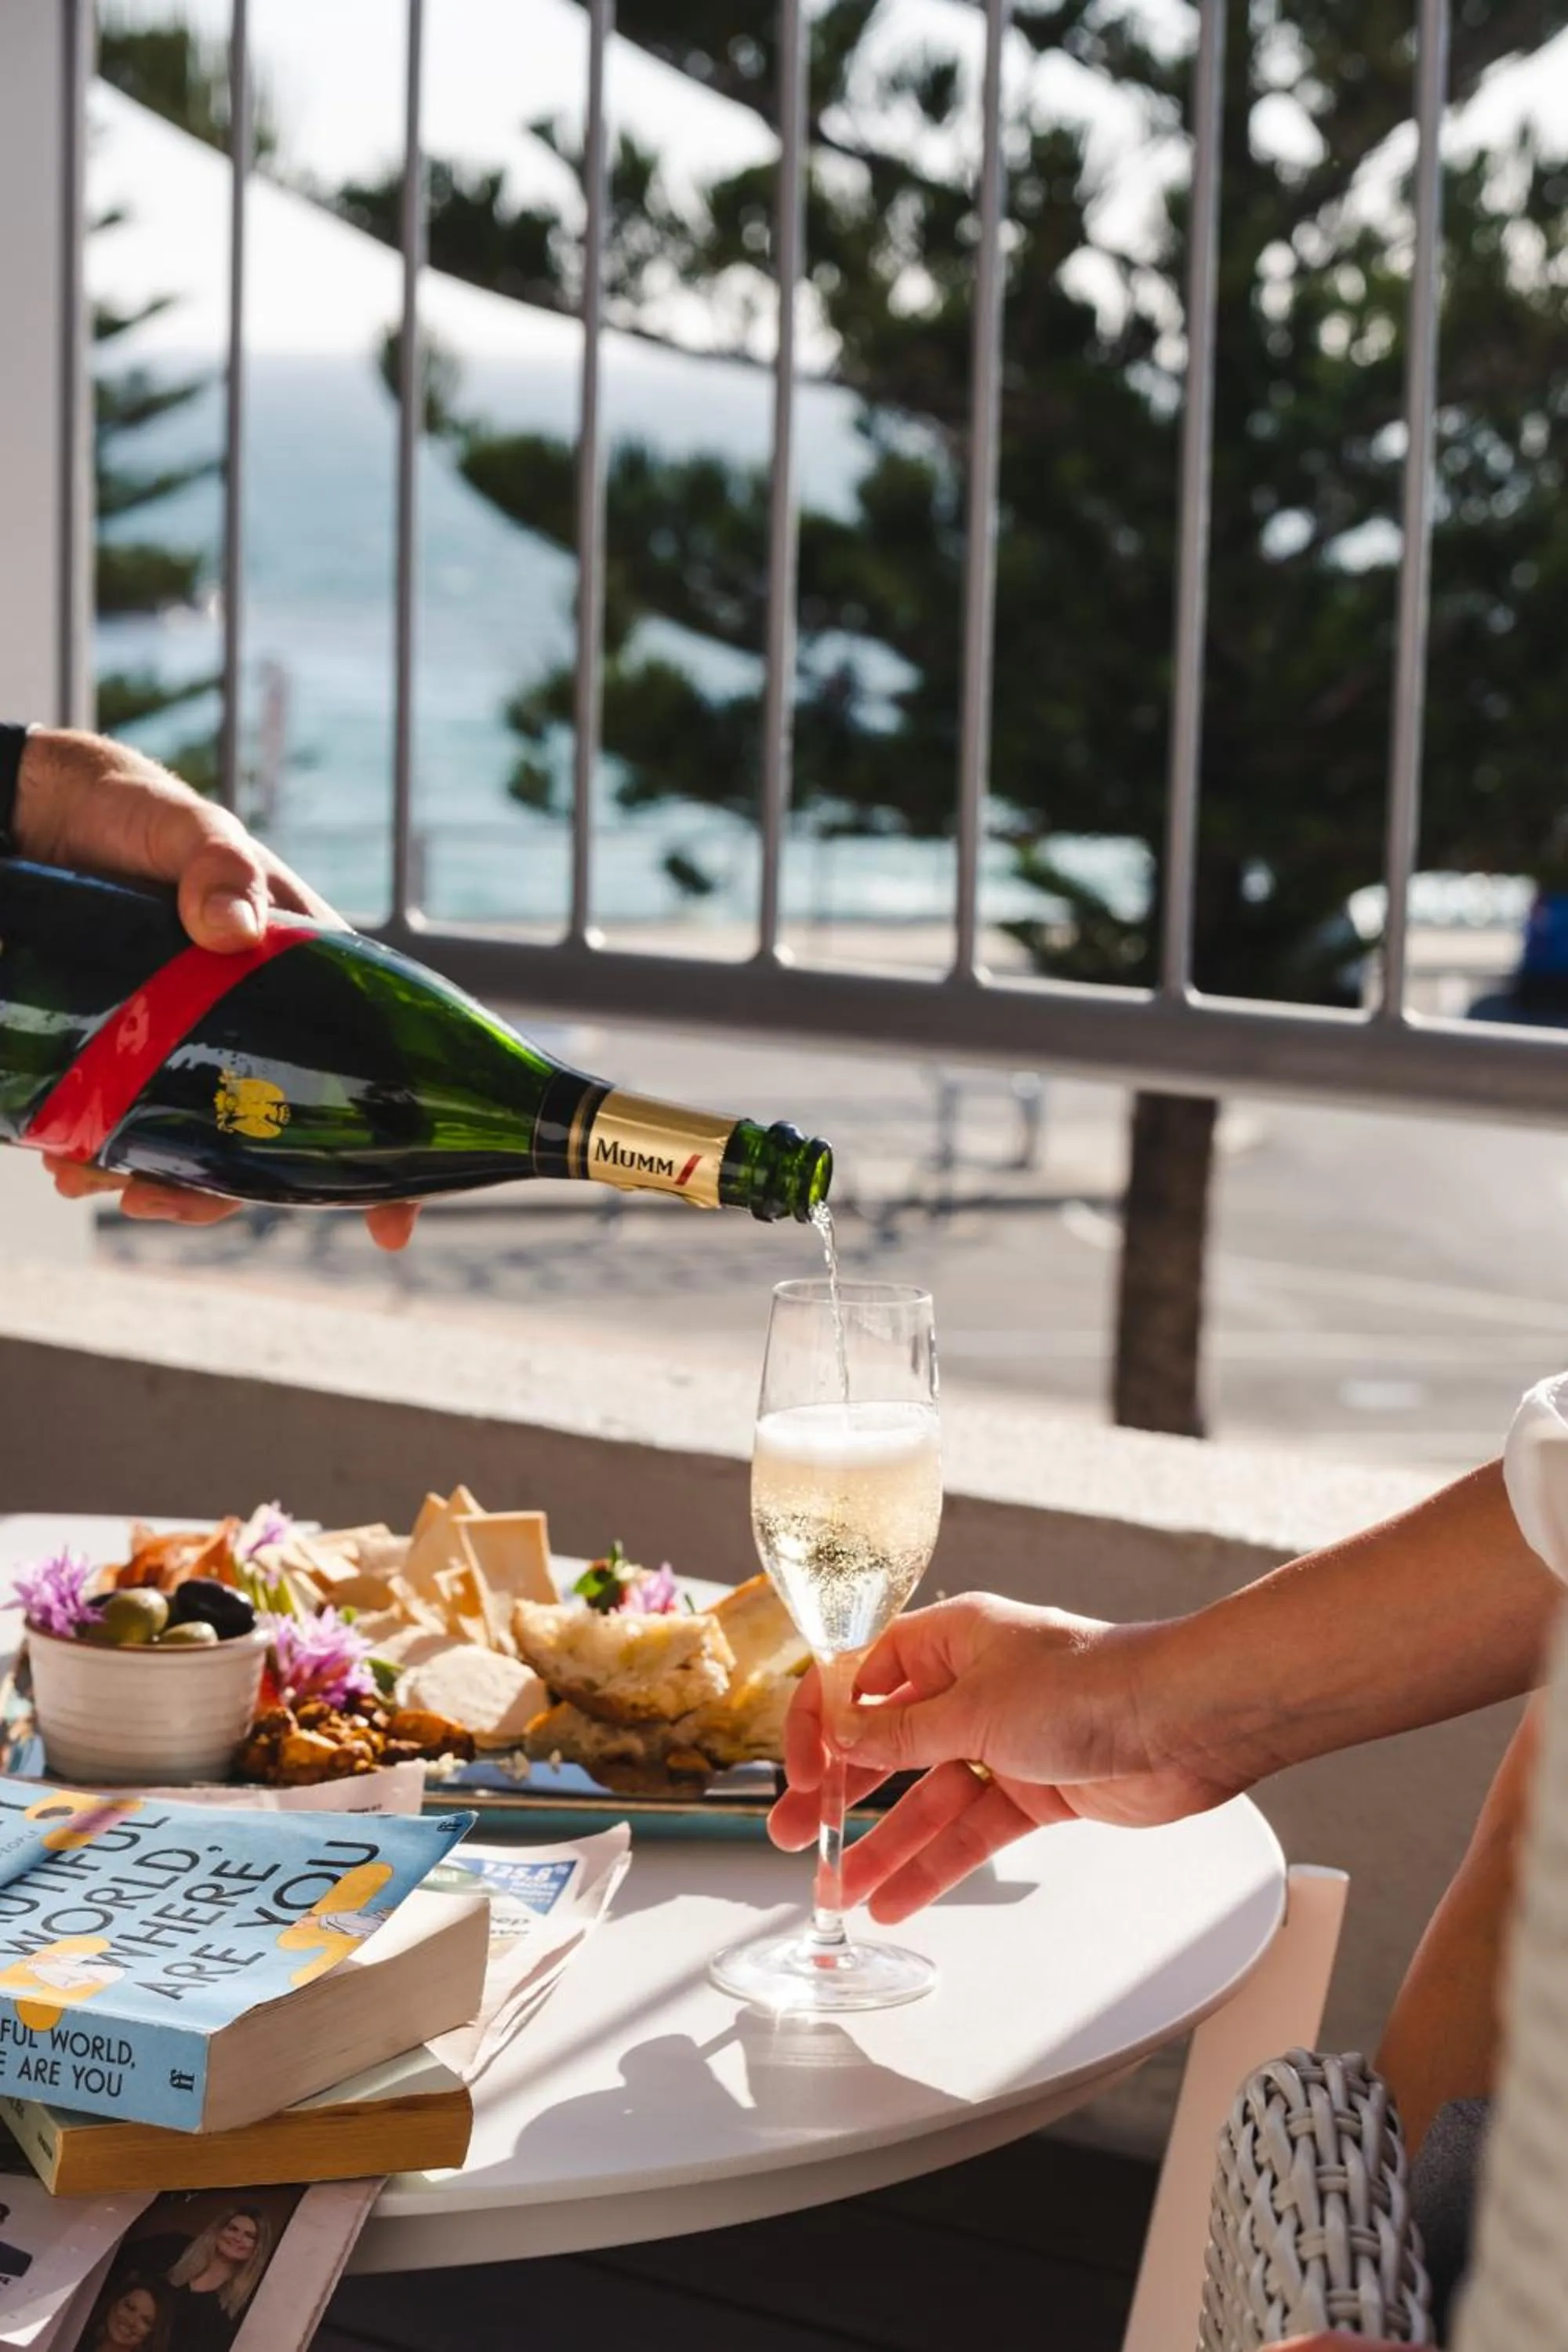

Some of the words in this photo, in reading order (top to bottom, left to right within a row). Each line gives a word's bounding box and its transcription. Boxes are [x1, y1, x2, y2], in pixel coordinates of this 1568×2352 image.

[0, 1817, 171, 1923] UTIFUL
[76, 1860, 281, 1969] WHERE
[133, 1944, 266, 2000] ARE
[234, 1840, 379, 1927] YOU
[17, 2056, 61, 2086] ARE
[72, 2064, 123, 2097] YOU
[51, 2028, 136, 2070] WORLD,
